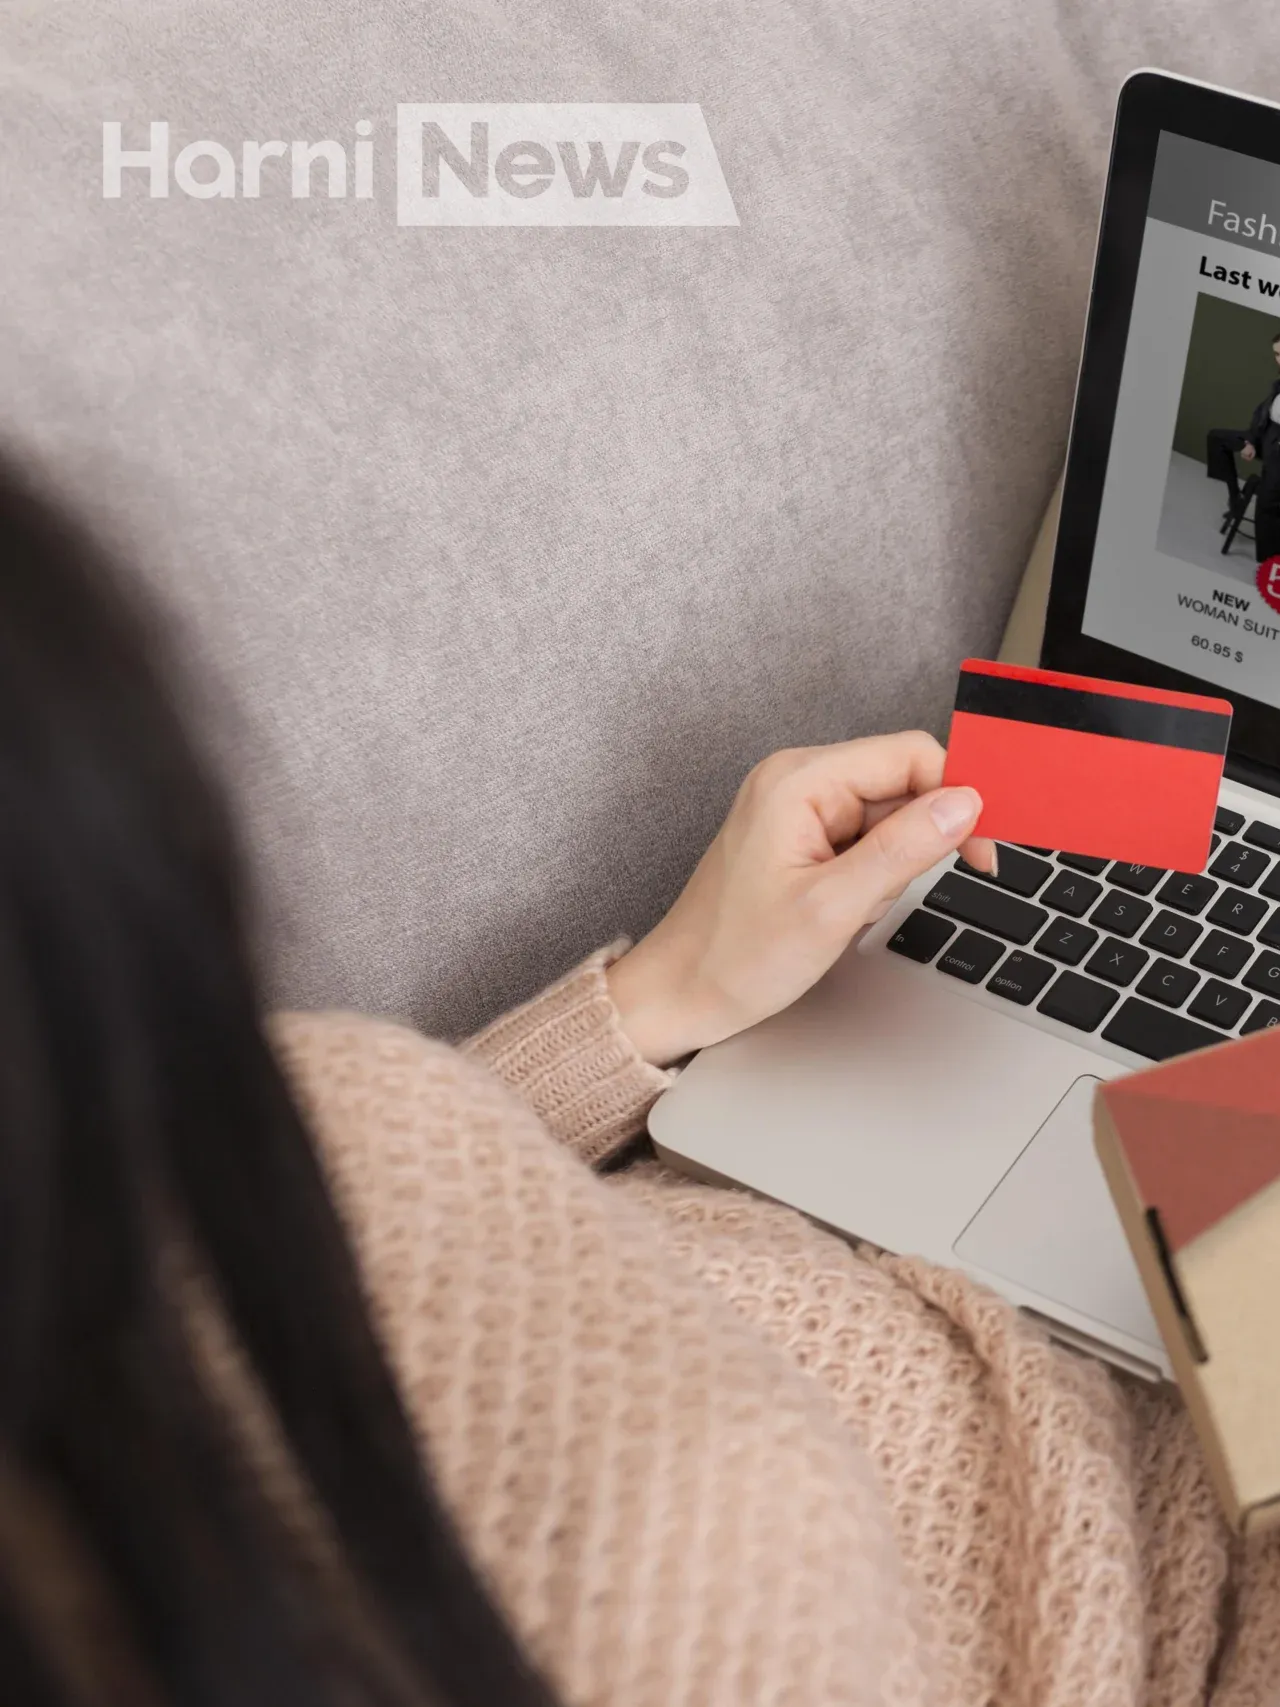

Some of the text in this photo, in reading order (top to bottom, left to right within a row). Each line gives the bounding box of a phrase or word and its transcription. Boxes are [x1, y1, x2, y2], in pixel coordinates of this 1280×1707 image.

[1199, 256, 1252, 290] Last
[1212, 589, 1250, 612] NEW
[1177, 593, 1280, 641] WOMAN SUIT
[1191, 635, 1244, 664] 60.95 $
[1239, 851, 1249, 860] $
[1129, 863, 1146, 875] W
[1230, 863, 1240, 872] 4
[1063, 886, 1075, 897] A
[1181, 884, 1193, 894] E
[1114, 906, 1126, 916] S
[1231, 903, 1243, 915] R
[1164, 925, 1177, 936] D
[894, 933, 905, 943] fn
[1059, 932, 1074, 944] Z
[1216, 946, 1229, 956] F
[944, 954, 976, 972] control
[1012, 954, 1023, 963] alt
[1108, 953, 1124, 966] X
[1268, 966, 1280, 978] G
[994, 976, 1022, 992] option
[1162, 974, 1175, 986] C
[1215, 994, 1228, 1006] V
[1266, 1016, 1278, 1028] B
